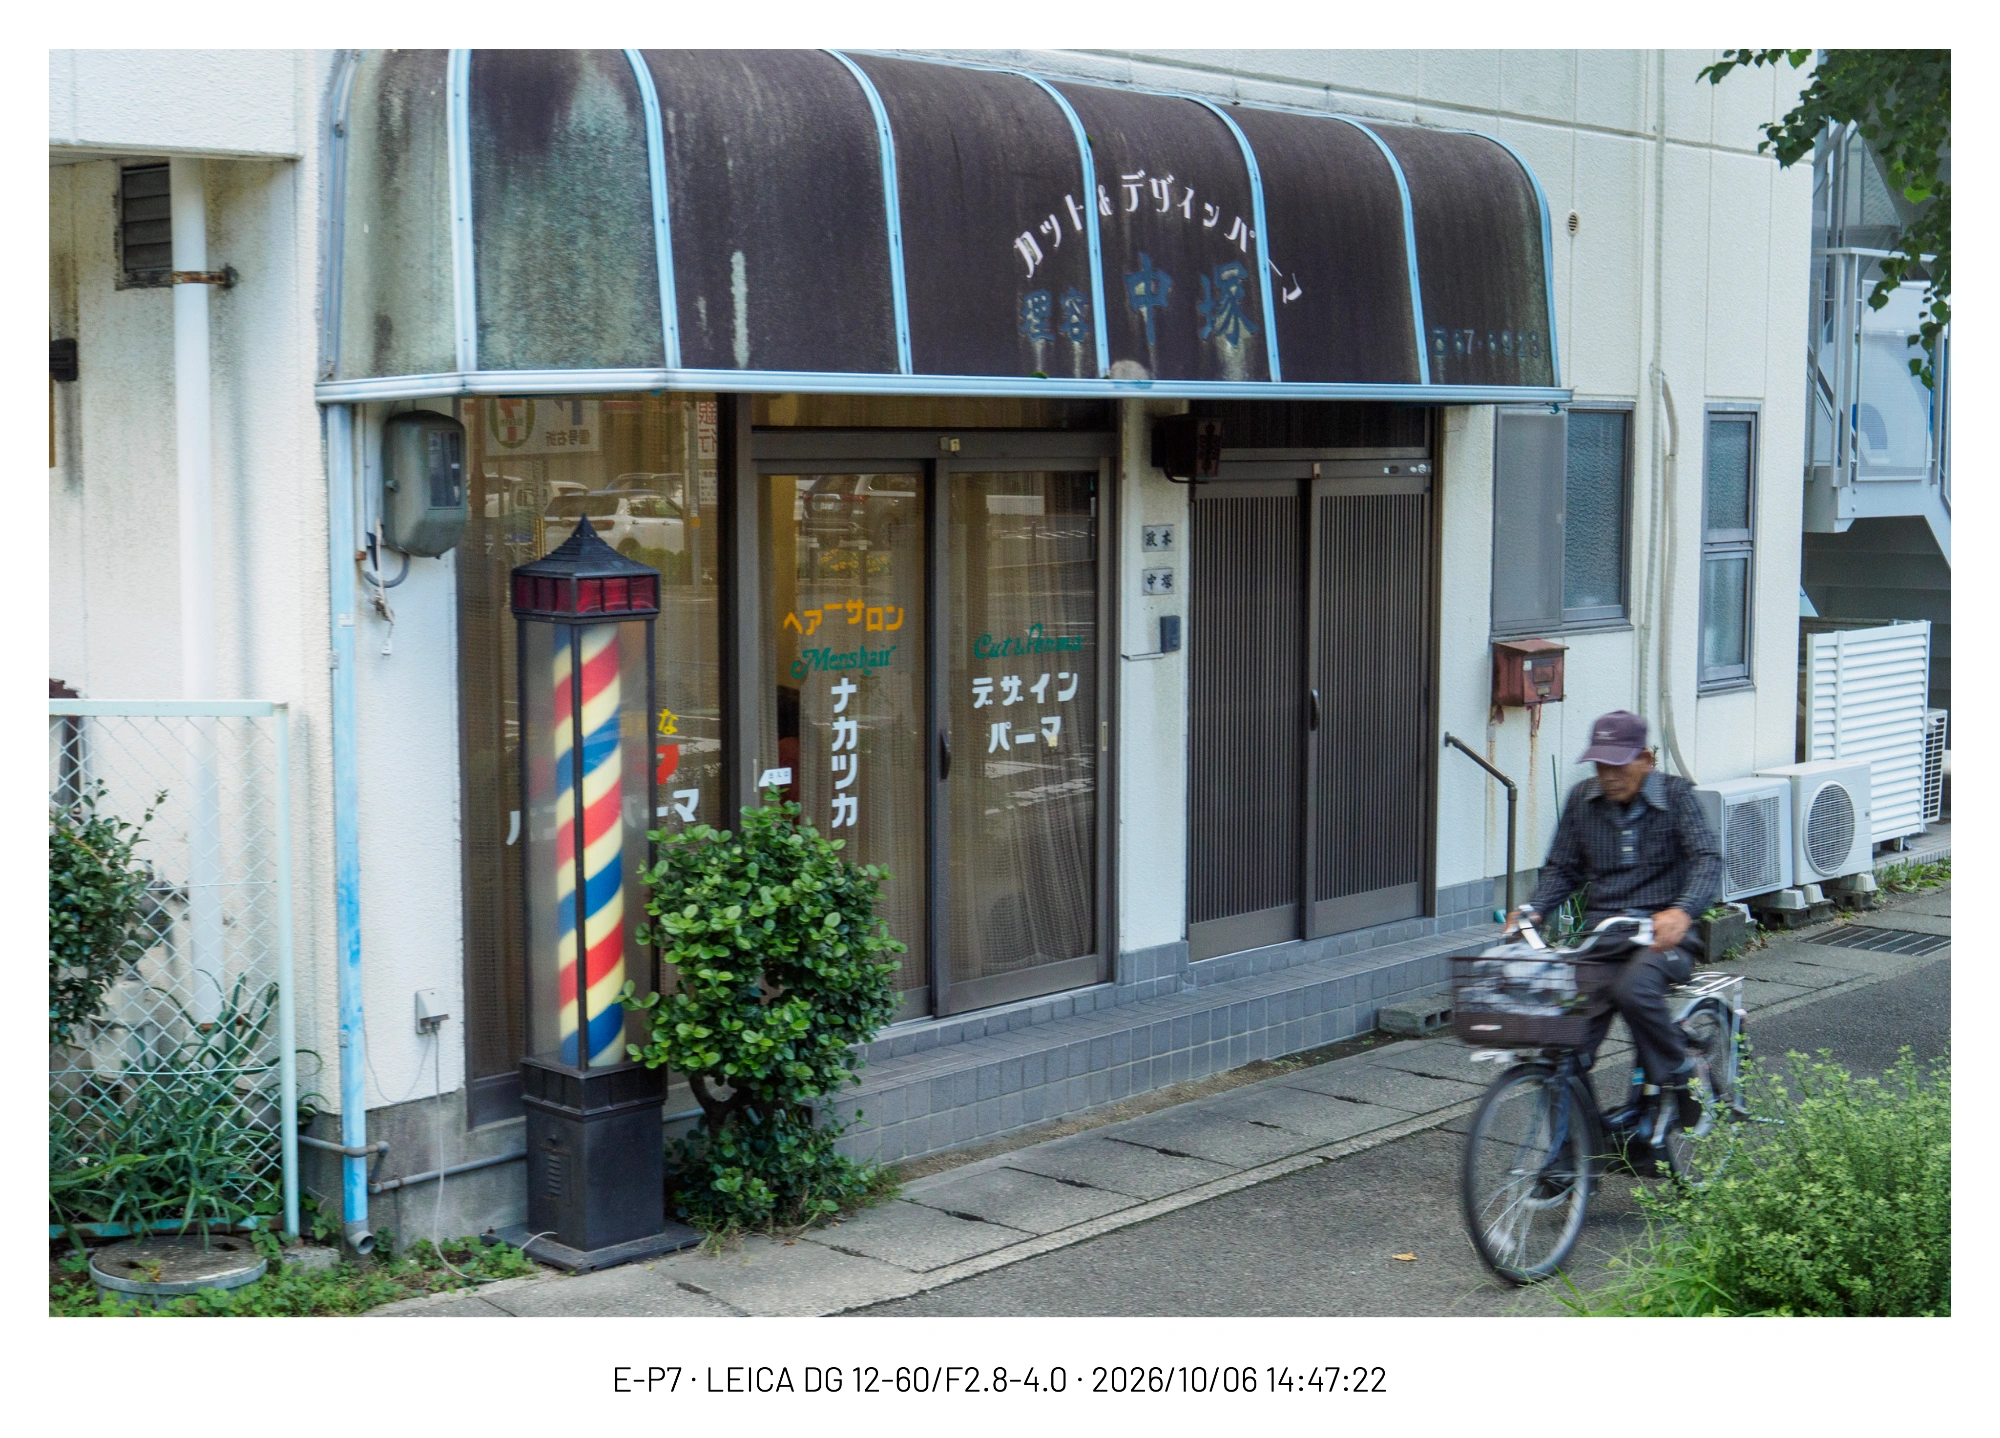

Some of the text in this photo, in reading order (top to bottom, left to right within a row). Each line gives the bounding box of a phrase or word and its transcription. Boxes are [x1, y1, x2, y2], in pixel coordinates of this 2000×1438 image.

[783, 599, 903, 636] ヘアーサロン
[972, 672, 1078, 709] デザイン
[988, 715, 1062, 753] パーマ
[830, 677, 860, 829] ナカツカ
